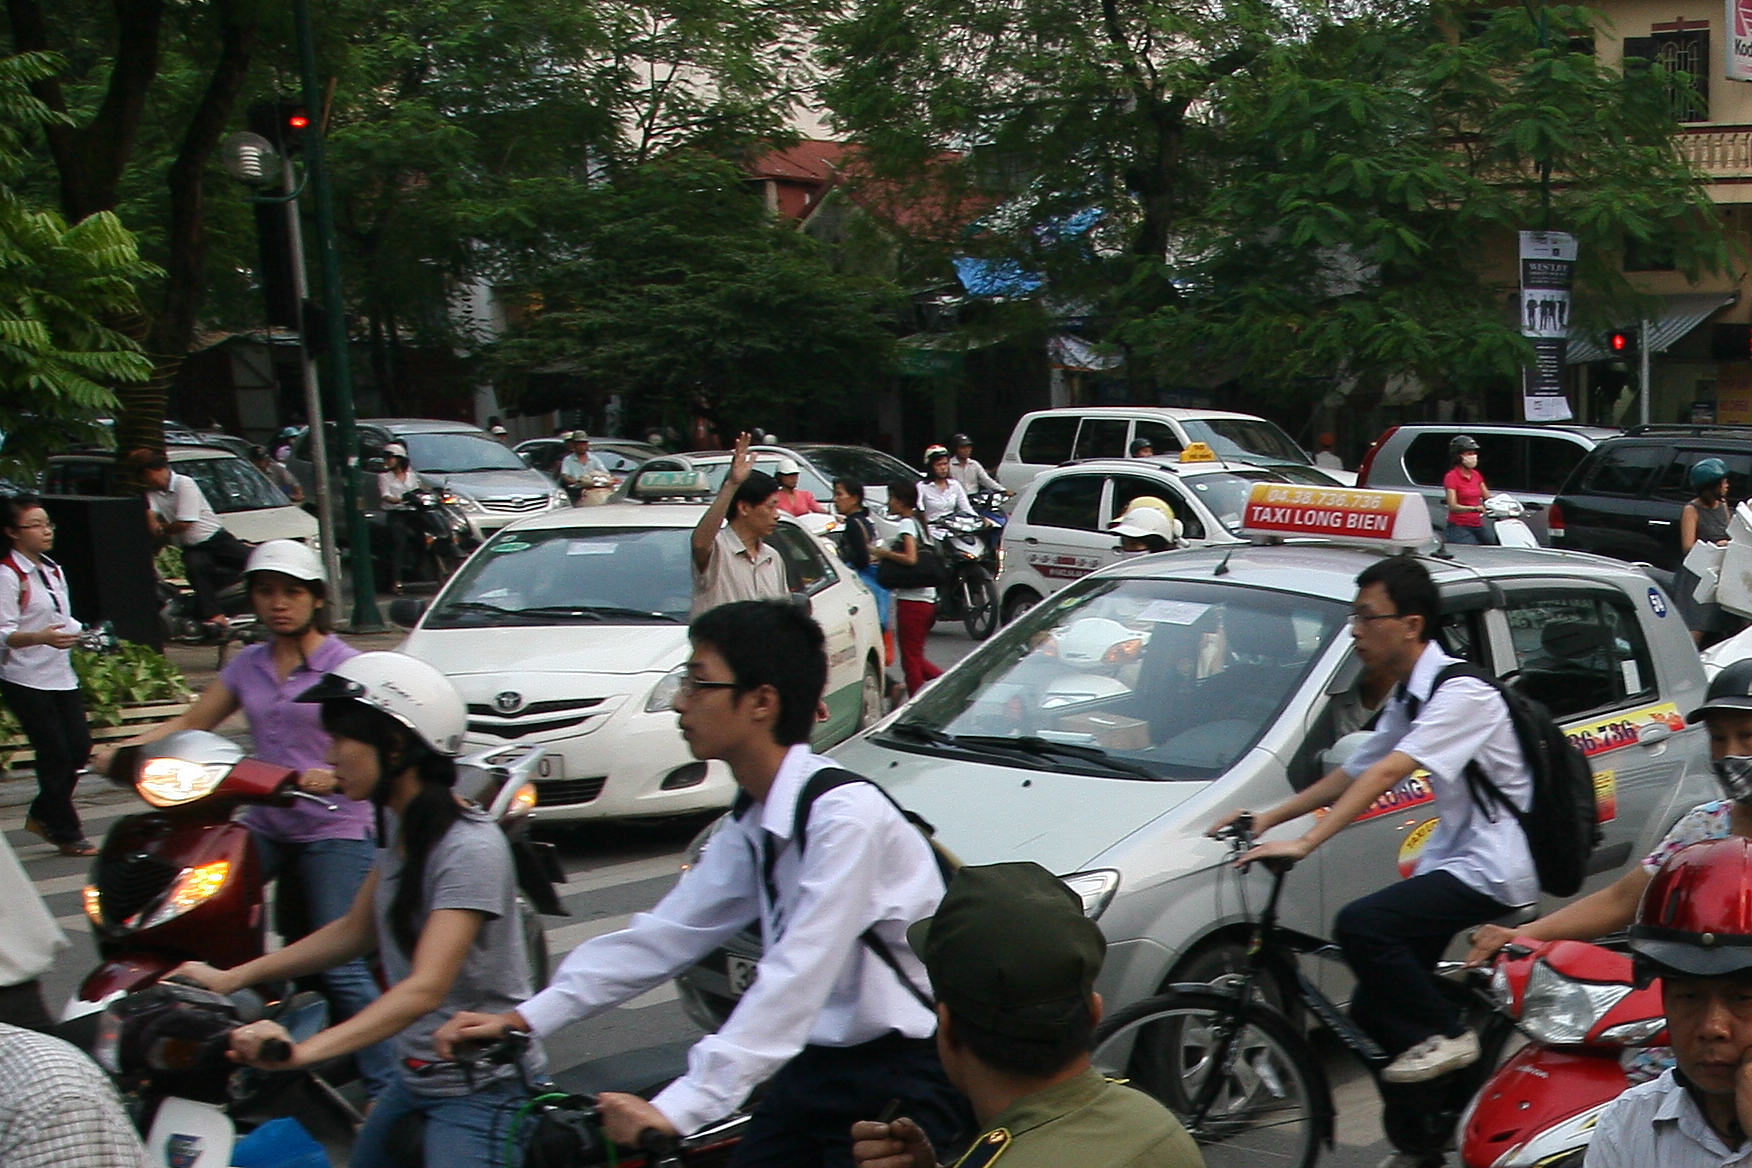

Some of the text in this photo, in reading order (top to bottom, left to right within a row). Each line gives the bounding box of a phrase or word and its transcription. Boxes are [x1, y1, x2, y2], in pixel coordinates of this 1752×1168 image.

[1267, 488, 1383, 510] 04.38.736.736
[1251, 505, 1389, 531] TAXI LONG BIEN
